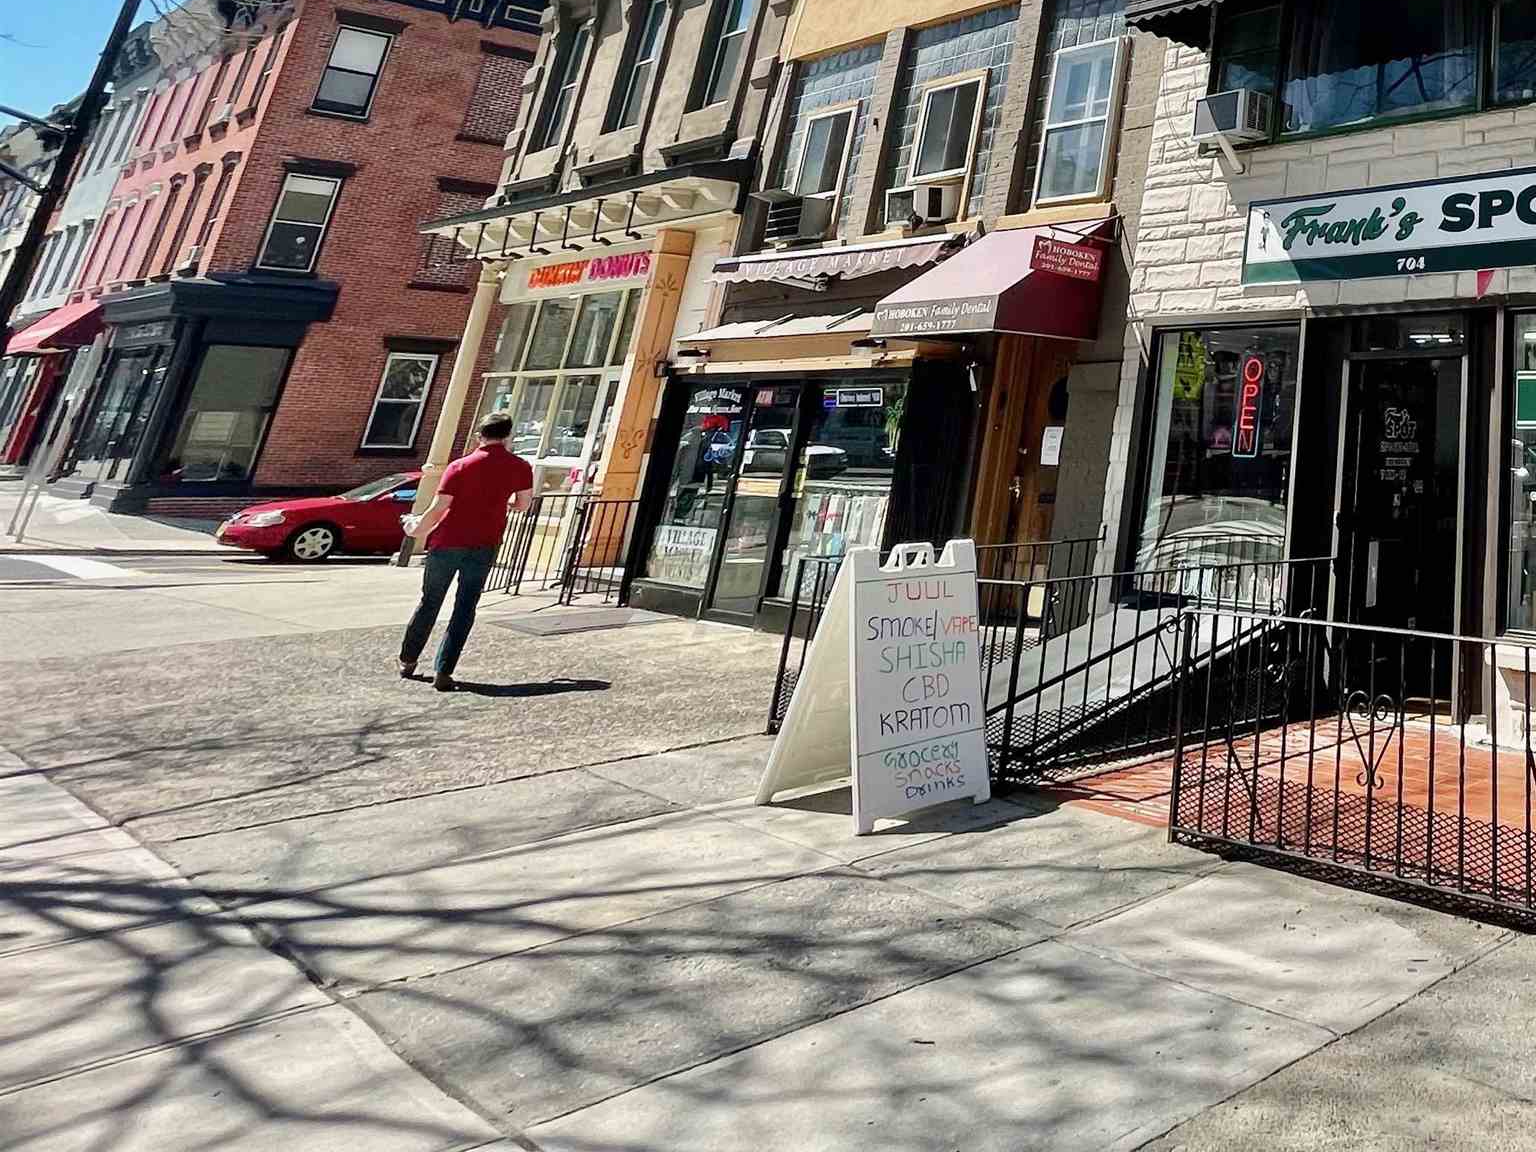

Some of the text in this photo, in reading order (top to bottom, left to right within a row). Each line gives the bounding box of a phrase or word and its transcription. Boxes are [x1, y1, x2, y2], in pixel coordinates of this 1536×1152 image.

[1281, 196, 1424, 250] Frank's
[588, 250, 651, 281] DONUTS
[744, 247, 905, 276] VILLAGE MARKET
[1035, 250, 1099, 270] Family Dental
[1053, 245, 1096, 262] HOBOKEN
[1397, 256, 1425, 271] 704
[888, 299, 991, 320] HOBOKEN Family Dental
[1237, 358, 1263, 453] OPEN
[887, 581, 954, 604] JUUL
[879, 640, 967, 674] SHISHA
[902, 673, 950, 704] CBD
[879, 702, 971, 737] KRATOM
